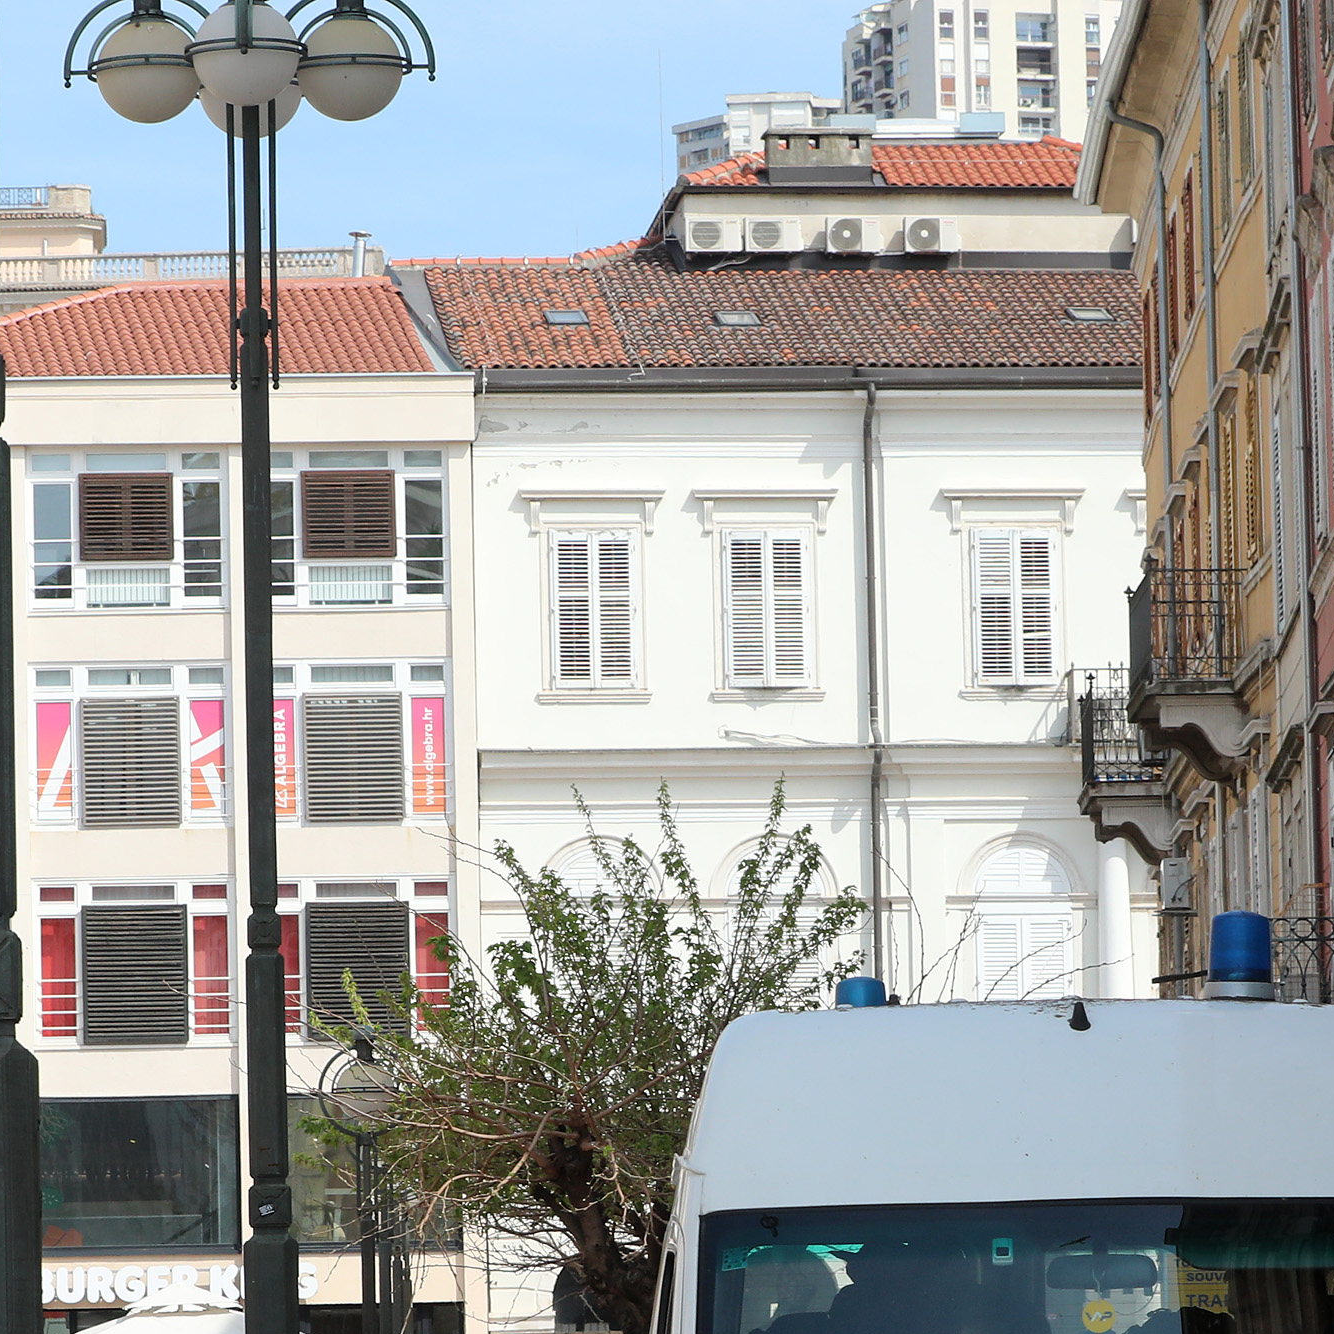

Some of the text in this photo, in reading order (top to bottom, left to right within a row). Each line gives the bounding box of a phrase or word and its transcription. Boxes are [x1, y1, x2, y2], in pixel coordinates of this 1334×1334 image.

[273, 708, 287, 786] ALGEBRA
[422, 707, 437, 806] www.algebra.hr
[210, 1264, 319, 1300] KG
